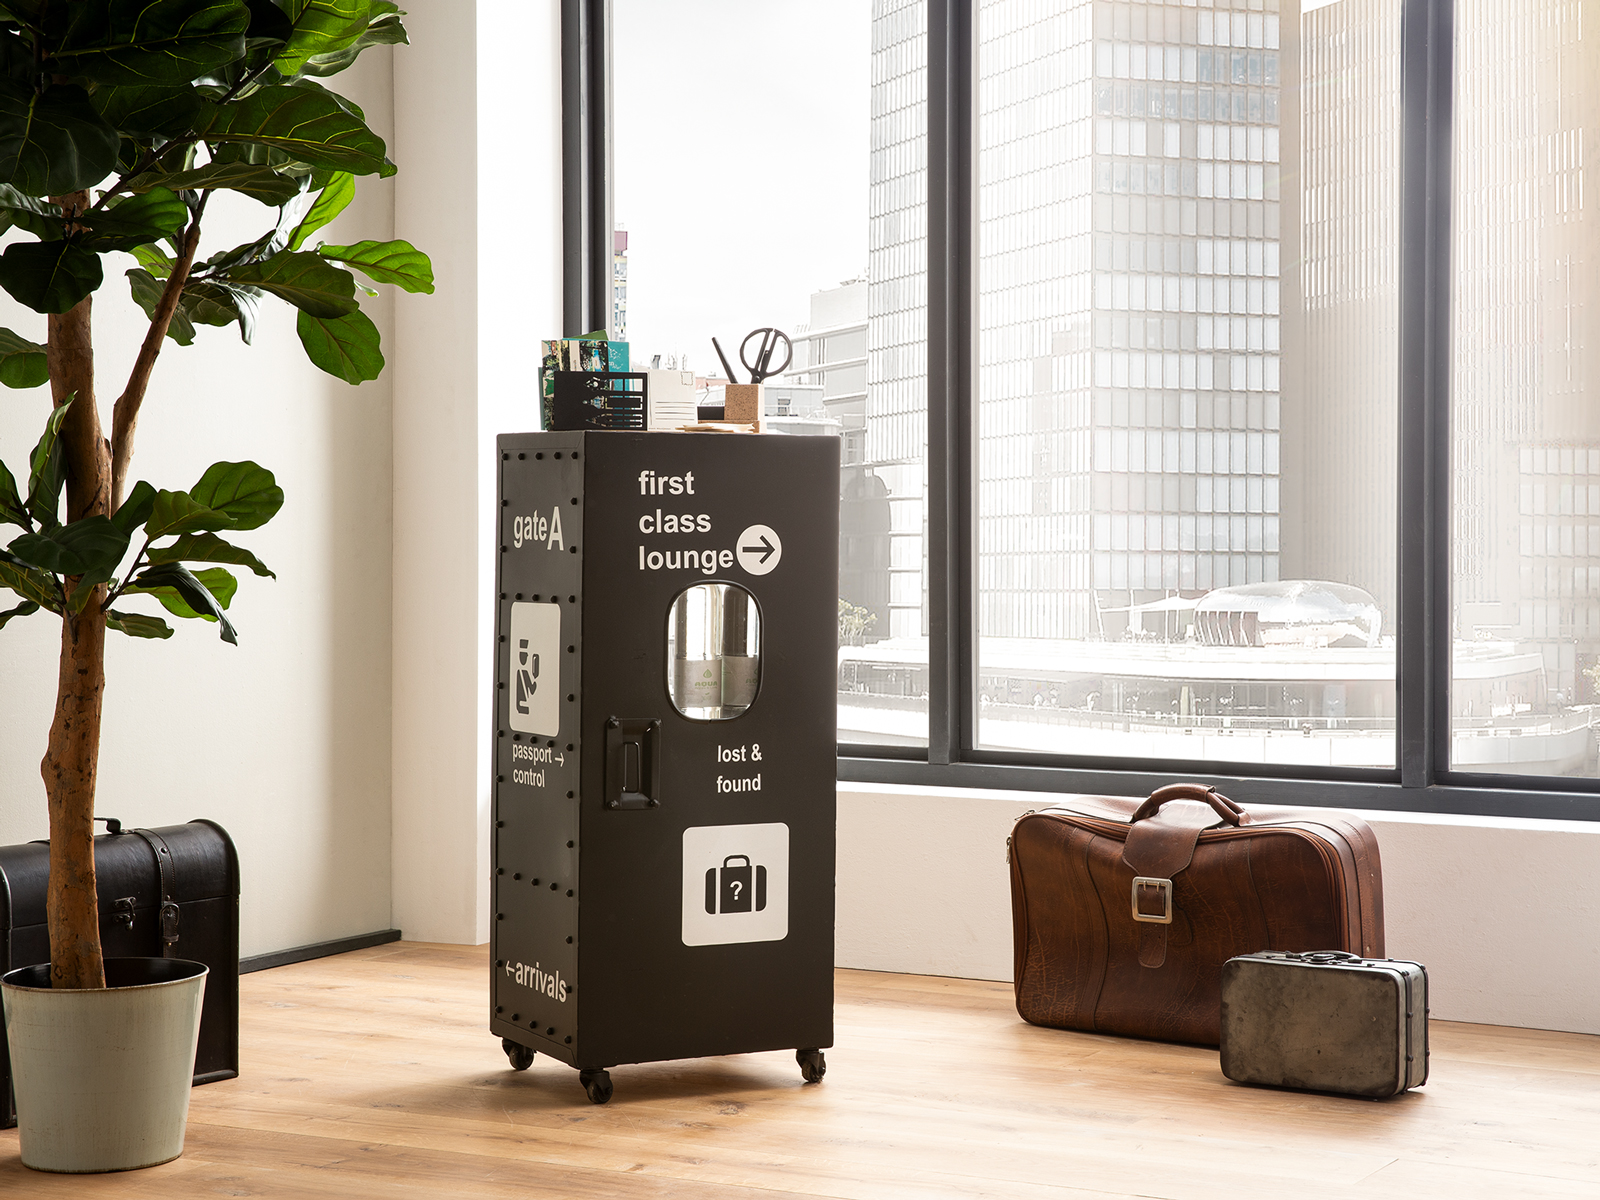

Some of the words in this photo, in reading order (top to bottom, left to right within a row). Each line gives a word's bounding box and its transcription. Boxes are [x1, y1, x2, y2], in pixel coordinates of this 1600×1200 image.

[638, 470, 695, 496] first
[638, 509, 712, 534] class
[639, 546, 734, 575] lounge
[512, 743, 552, 765] passport
[717, 744, 747, 763] lost
[750, 743, 763, 762] &
[512, 769, 545, 788] control
[716, 774, 762, 794] found
[515, 961, 567, 1003] arrivals
